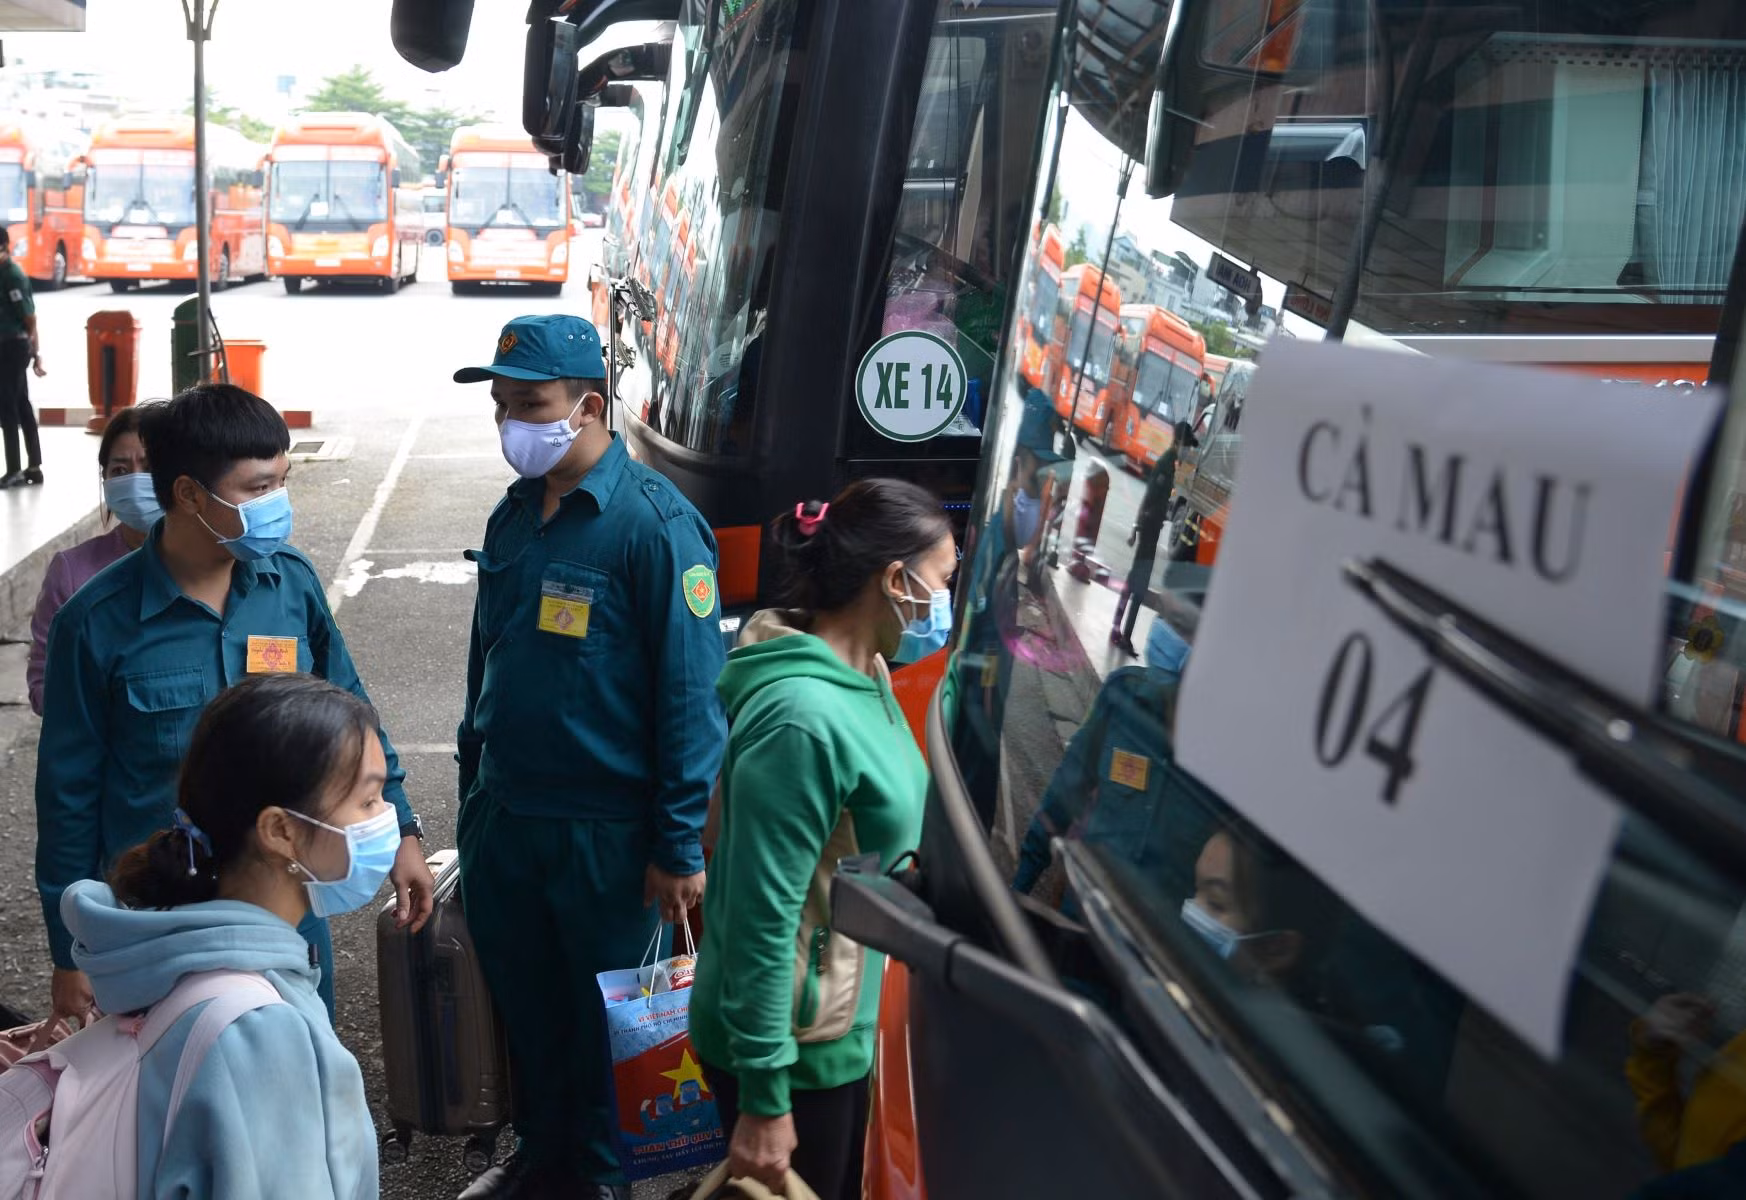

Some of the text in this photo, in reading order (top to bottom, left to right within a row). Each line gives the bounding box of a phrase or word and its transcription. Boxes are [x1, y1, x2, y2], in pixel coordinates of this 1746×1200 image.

[874, 362, 953, 410] XE 14
[1394, 438, 1594, 586] MAU
[1315, 628, 1435, 808] 04
